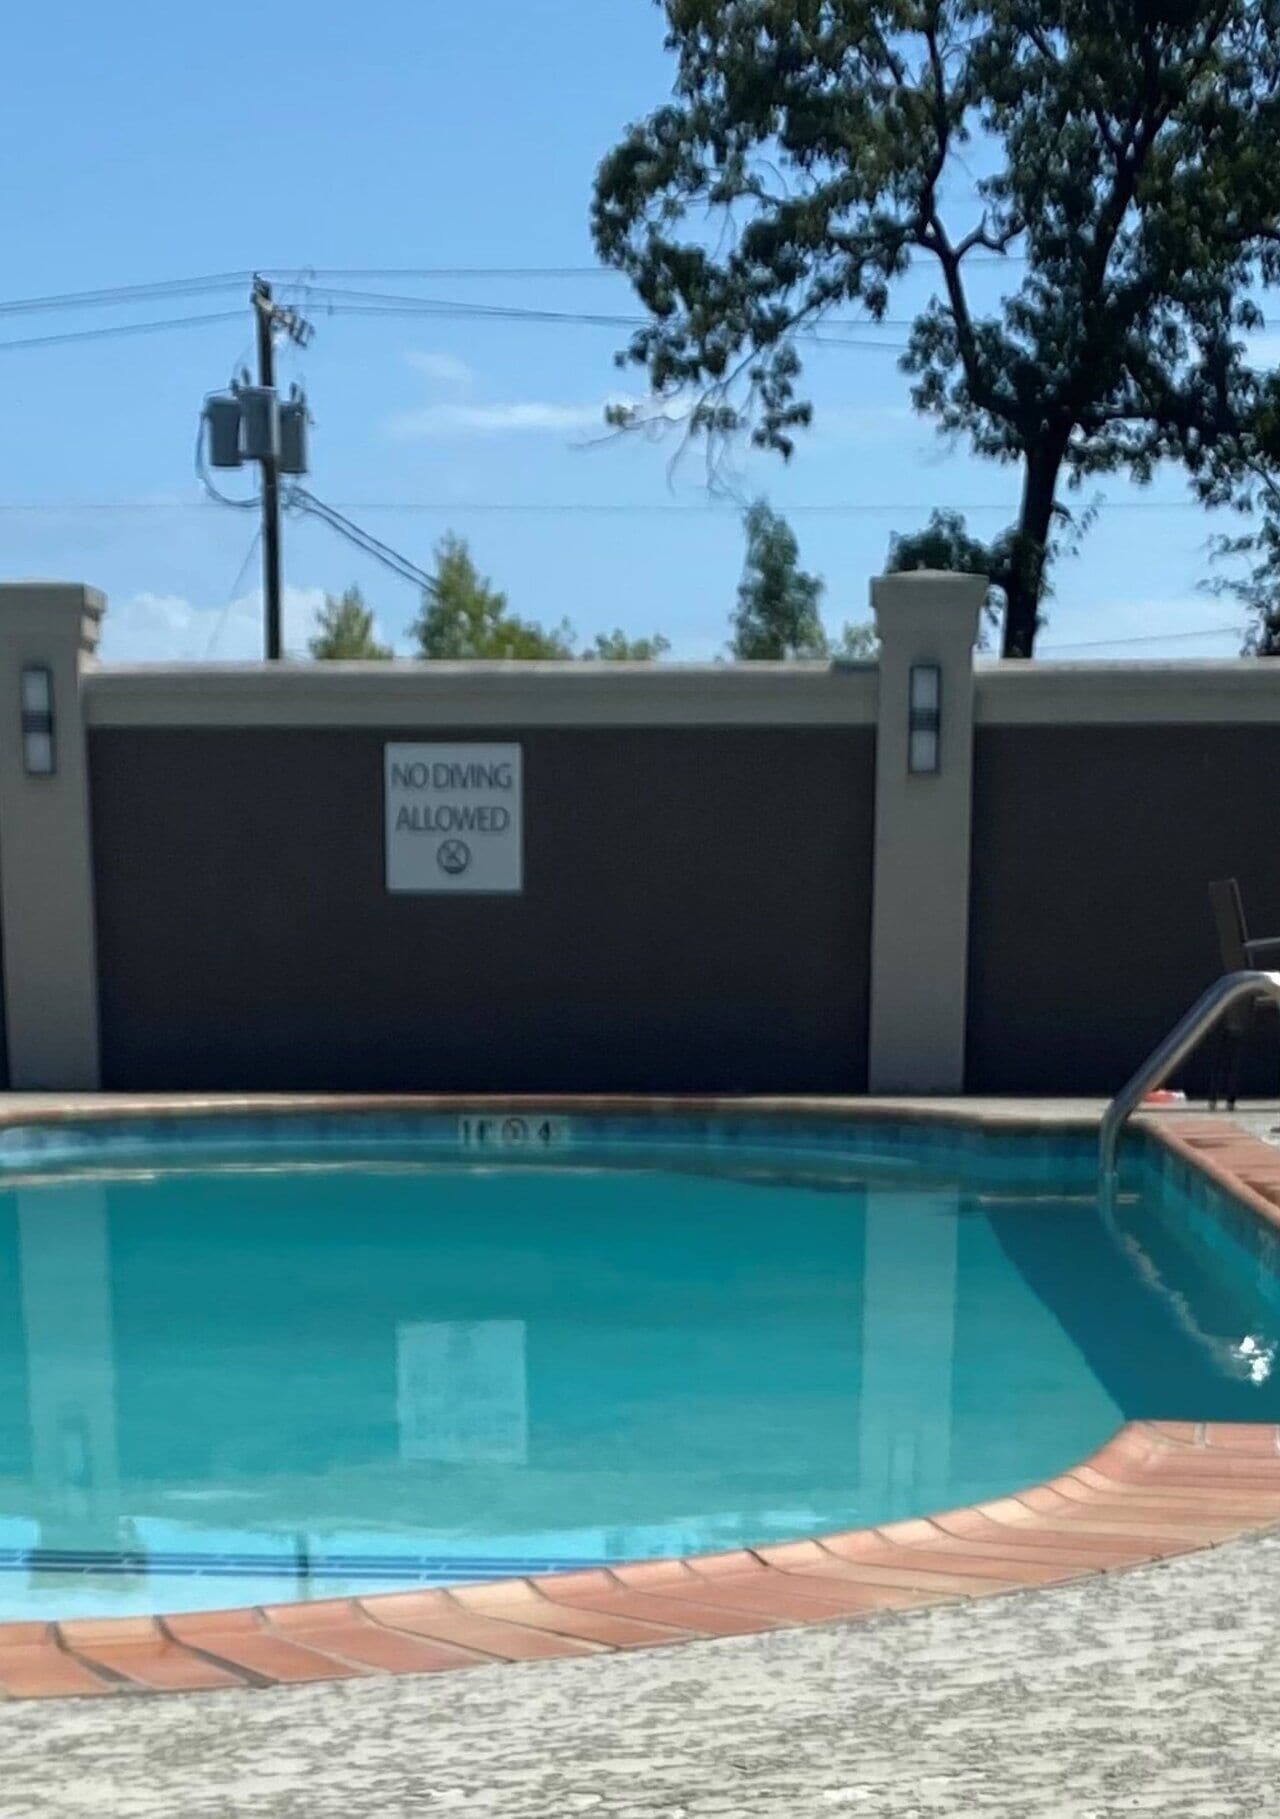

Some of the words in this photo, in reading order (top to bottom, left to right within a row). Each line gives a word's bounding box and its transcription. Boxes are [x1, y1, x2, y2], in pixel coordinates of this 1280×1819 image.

[391, 762, 429, 789] NO
[433, 762, 513, 789] DIVING
[395, 805, 511, 832] ALLOWED
